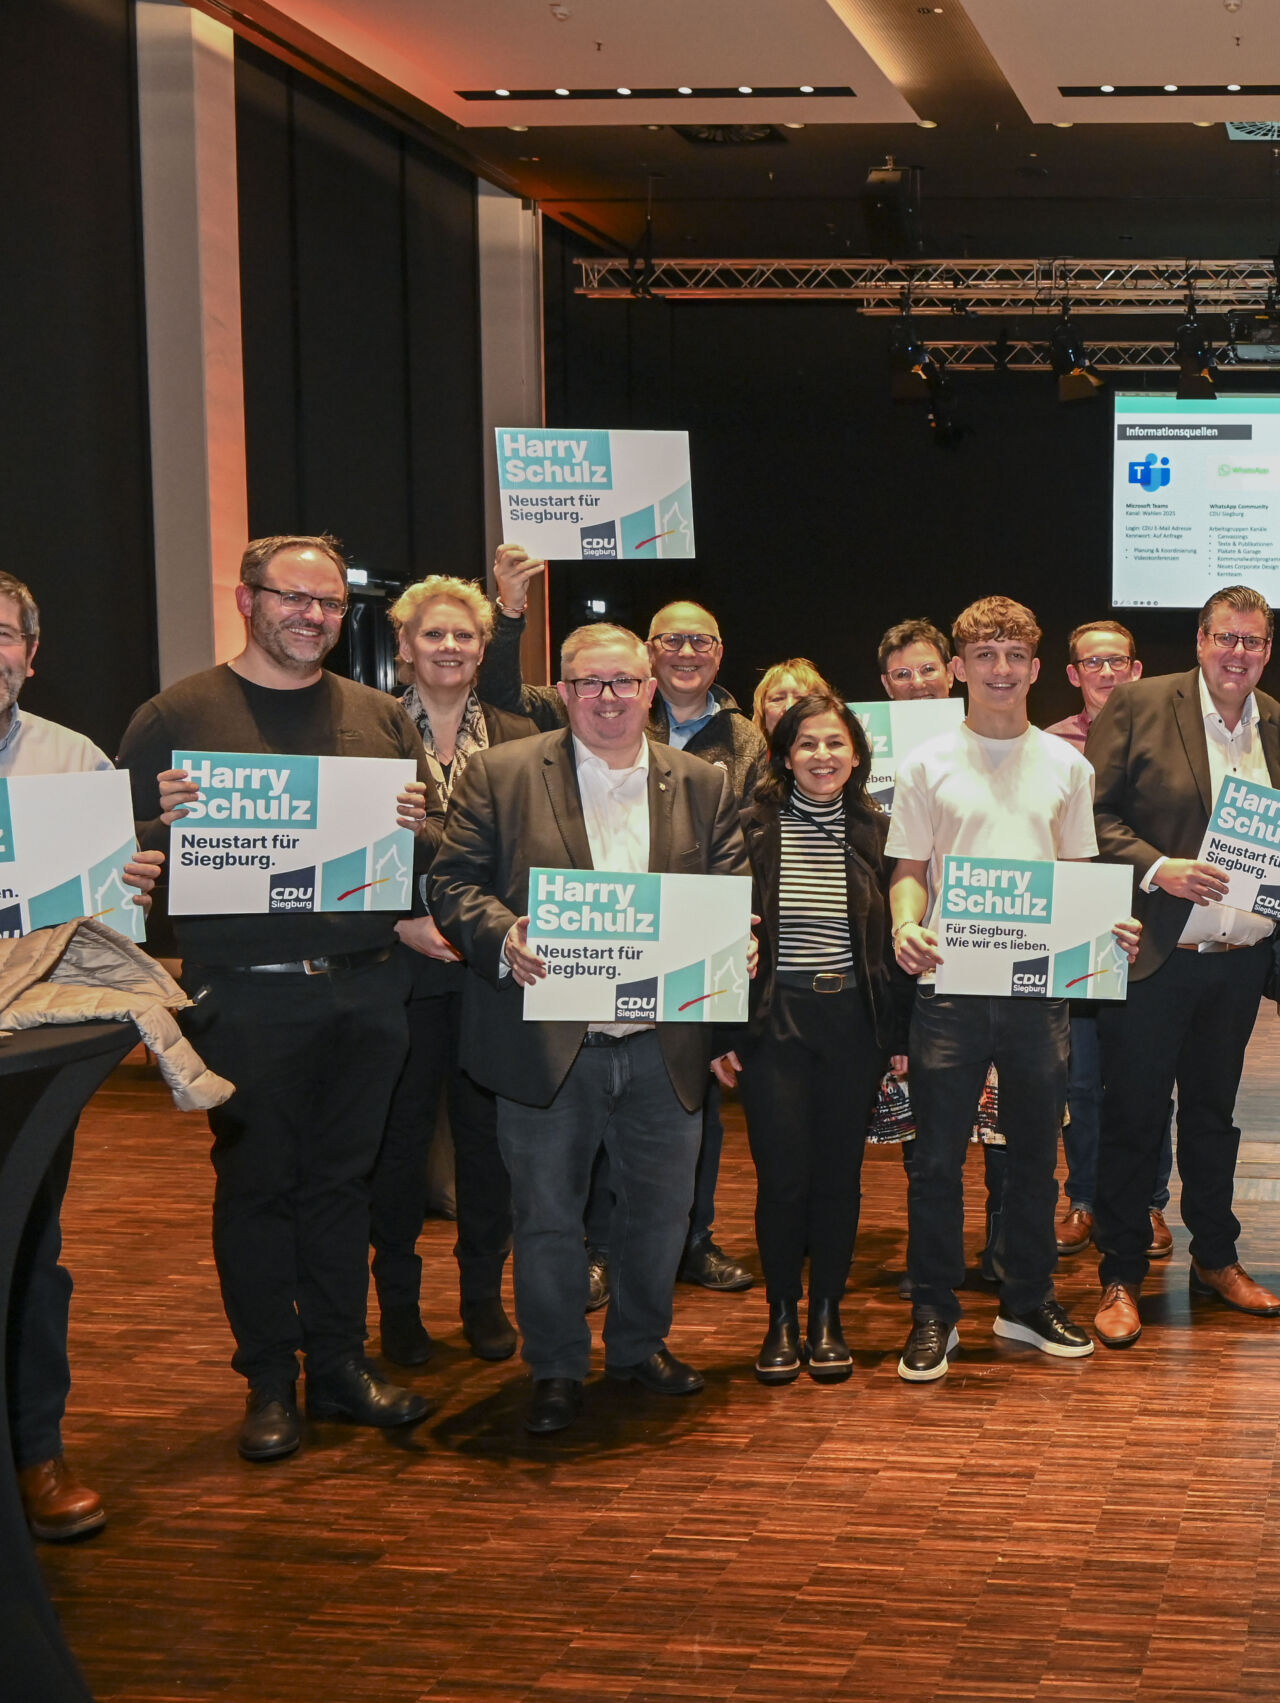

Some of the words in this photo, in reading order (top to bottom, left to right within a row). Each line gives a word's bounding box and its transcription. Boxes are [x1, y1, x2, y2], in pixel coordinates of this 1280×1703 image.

[1126, 427, 1218, 438] Informationsquellen
[503, 434, 588, 463] Harry
[506, 459, 607, 483] Schulz
[1134, 466, 1144, 479] T
[508, 495, 575, 507] Neustart
[579, 495, 600, 506] für
[510, 509, 583, 523] Siegburg.
[583, 538, 615, 549] CDU
[584, 549, 615, 557] Siegburg
[182, 759, 290, 796] Harry
[183, 792, 311, 821] Schulz
[182, 834, 267, 849] Neustart
[272, 834, 299, 848] für
[1209, 838, 1267, 864] Neustart
[181, 852, 275, 869] Siegburg.
[1205, 851, 1267, 879] Siegburg.
[948, 861, 1032, 895] Harry
[271, 887, 313, 899] CDU
[538, 874, 635, 910] Harry
[271, 900, 312, 909] Siegburg
[946, 888, 1047, 917] Schulz
[536, 904, 655, 933] Schulz
[946, 924, 966, 934] Für
[969, 924, 1026, 938] Siegburg.
[945, 937, 969, 947] Wie
[972, 939, 991, 948] wir
[994, 941, 1007, 949] es
[1010, 941, 1050, 951] lieben.
[536, 944, 614, 959] Neustart
[618, 946, 644, 960] für
[545, 961, 621, 979] iegburg.
[1013, 974, 1046, 985] CDU
[1013, 985, 1045, 993] Siegburg
[617, 997, 655, 1009] CDU
[617, 1010, 655, 1019] Siegburg
